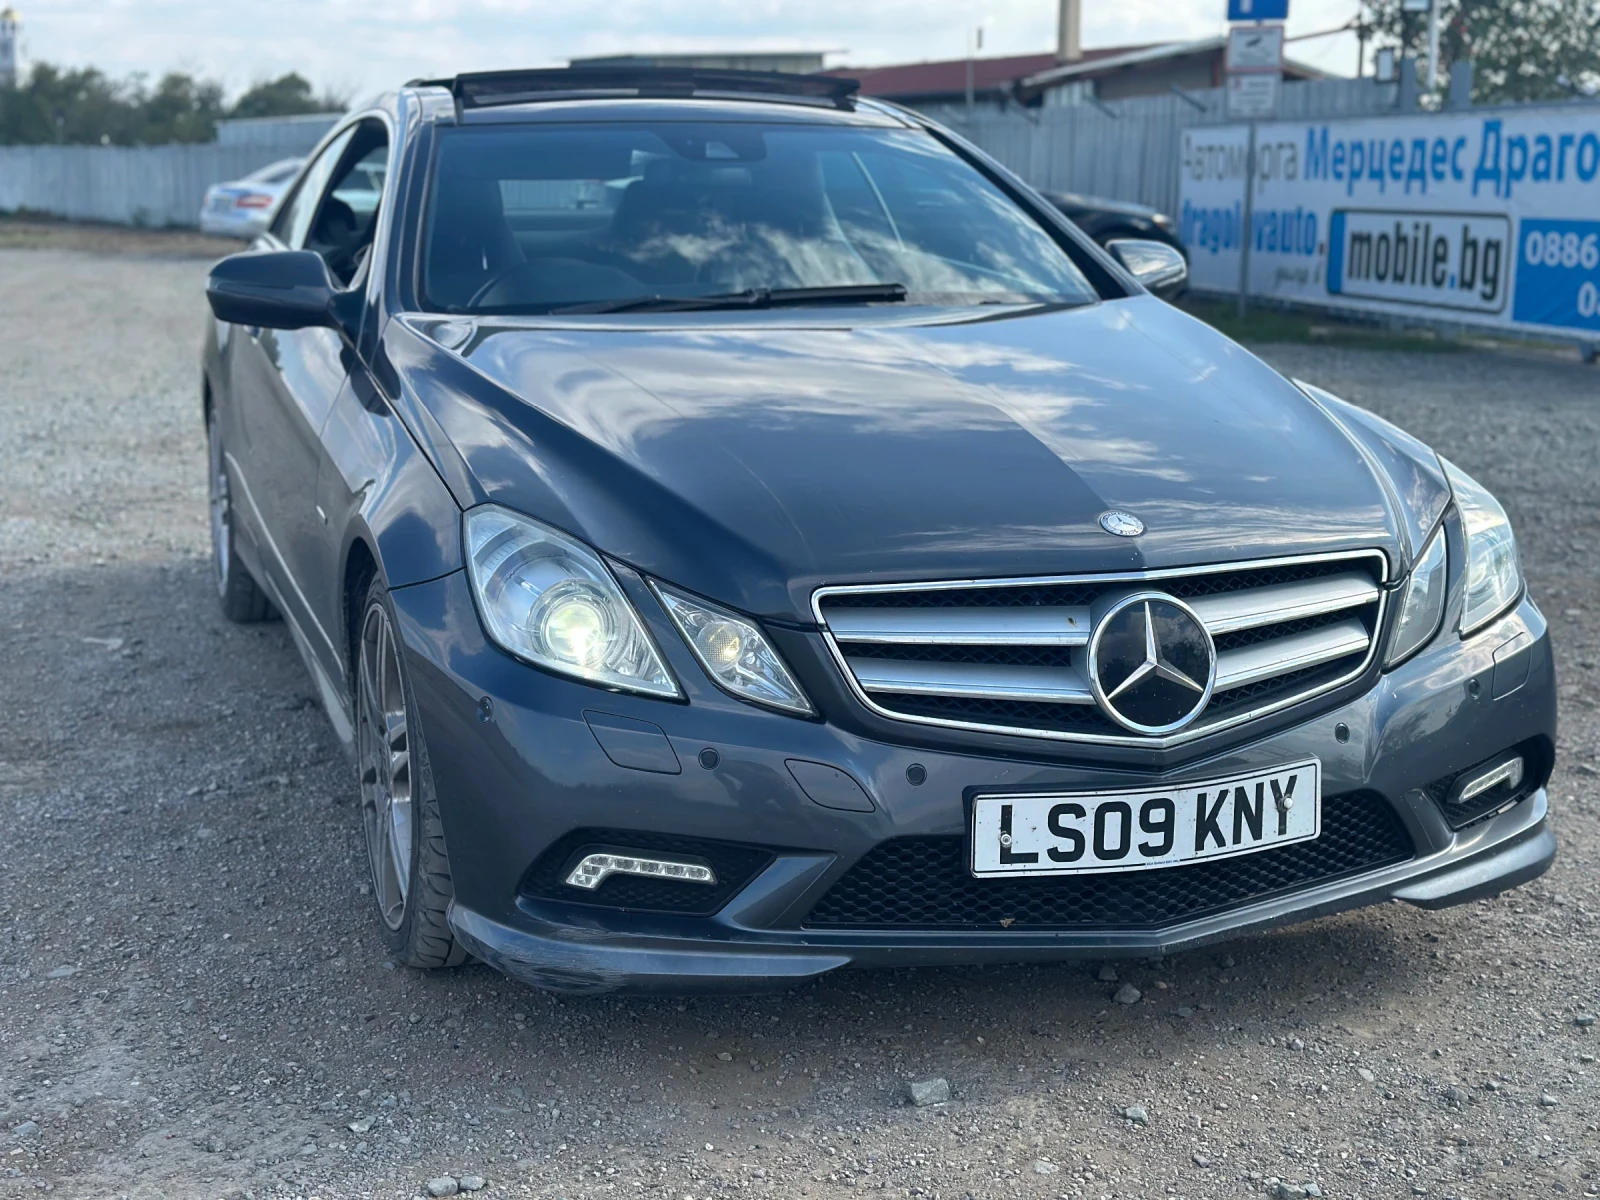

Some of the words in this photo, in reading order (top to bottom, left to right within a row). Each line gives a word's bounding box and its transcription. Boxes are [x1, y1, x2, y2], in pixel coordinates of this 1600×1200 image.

[1304, 126, 1467, 197] Мерцедес
[1472, 119, 1600, 200] Драго
[1347, 221, 1503, 301] mobile.bg
[1525, 230, 1599, 270] 0886
[1577, 281, 1600, 319] 0
[1000, 797, 1176, 865] LS09
[1194, 774, 1298, 852] KNY
